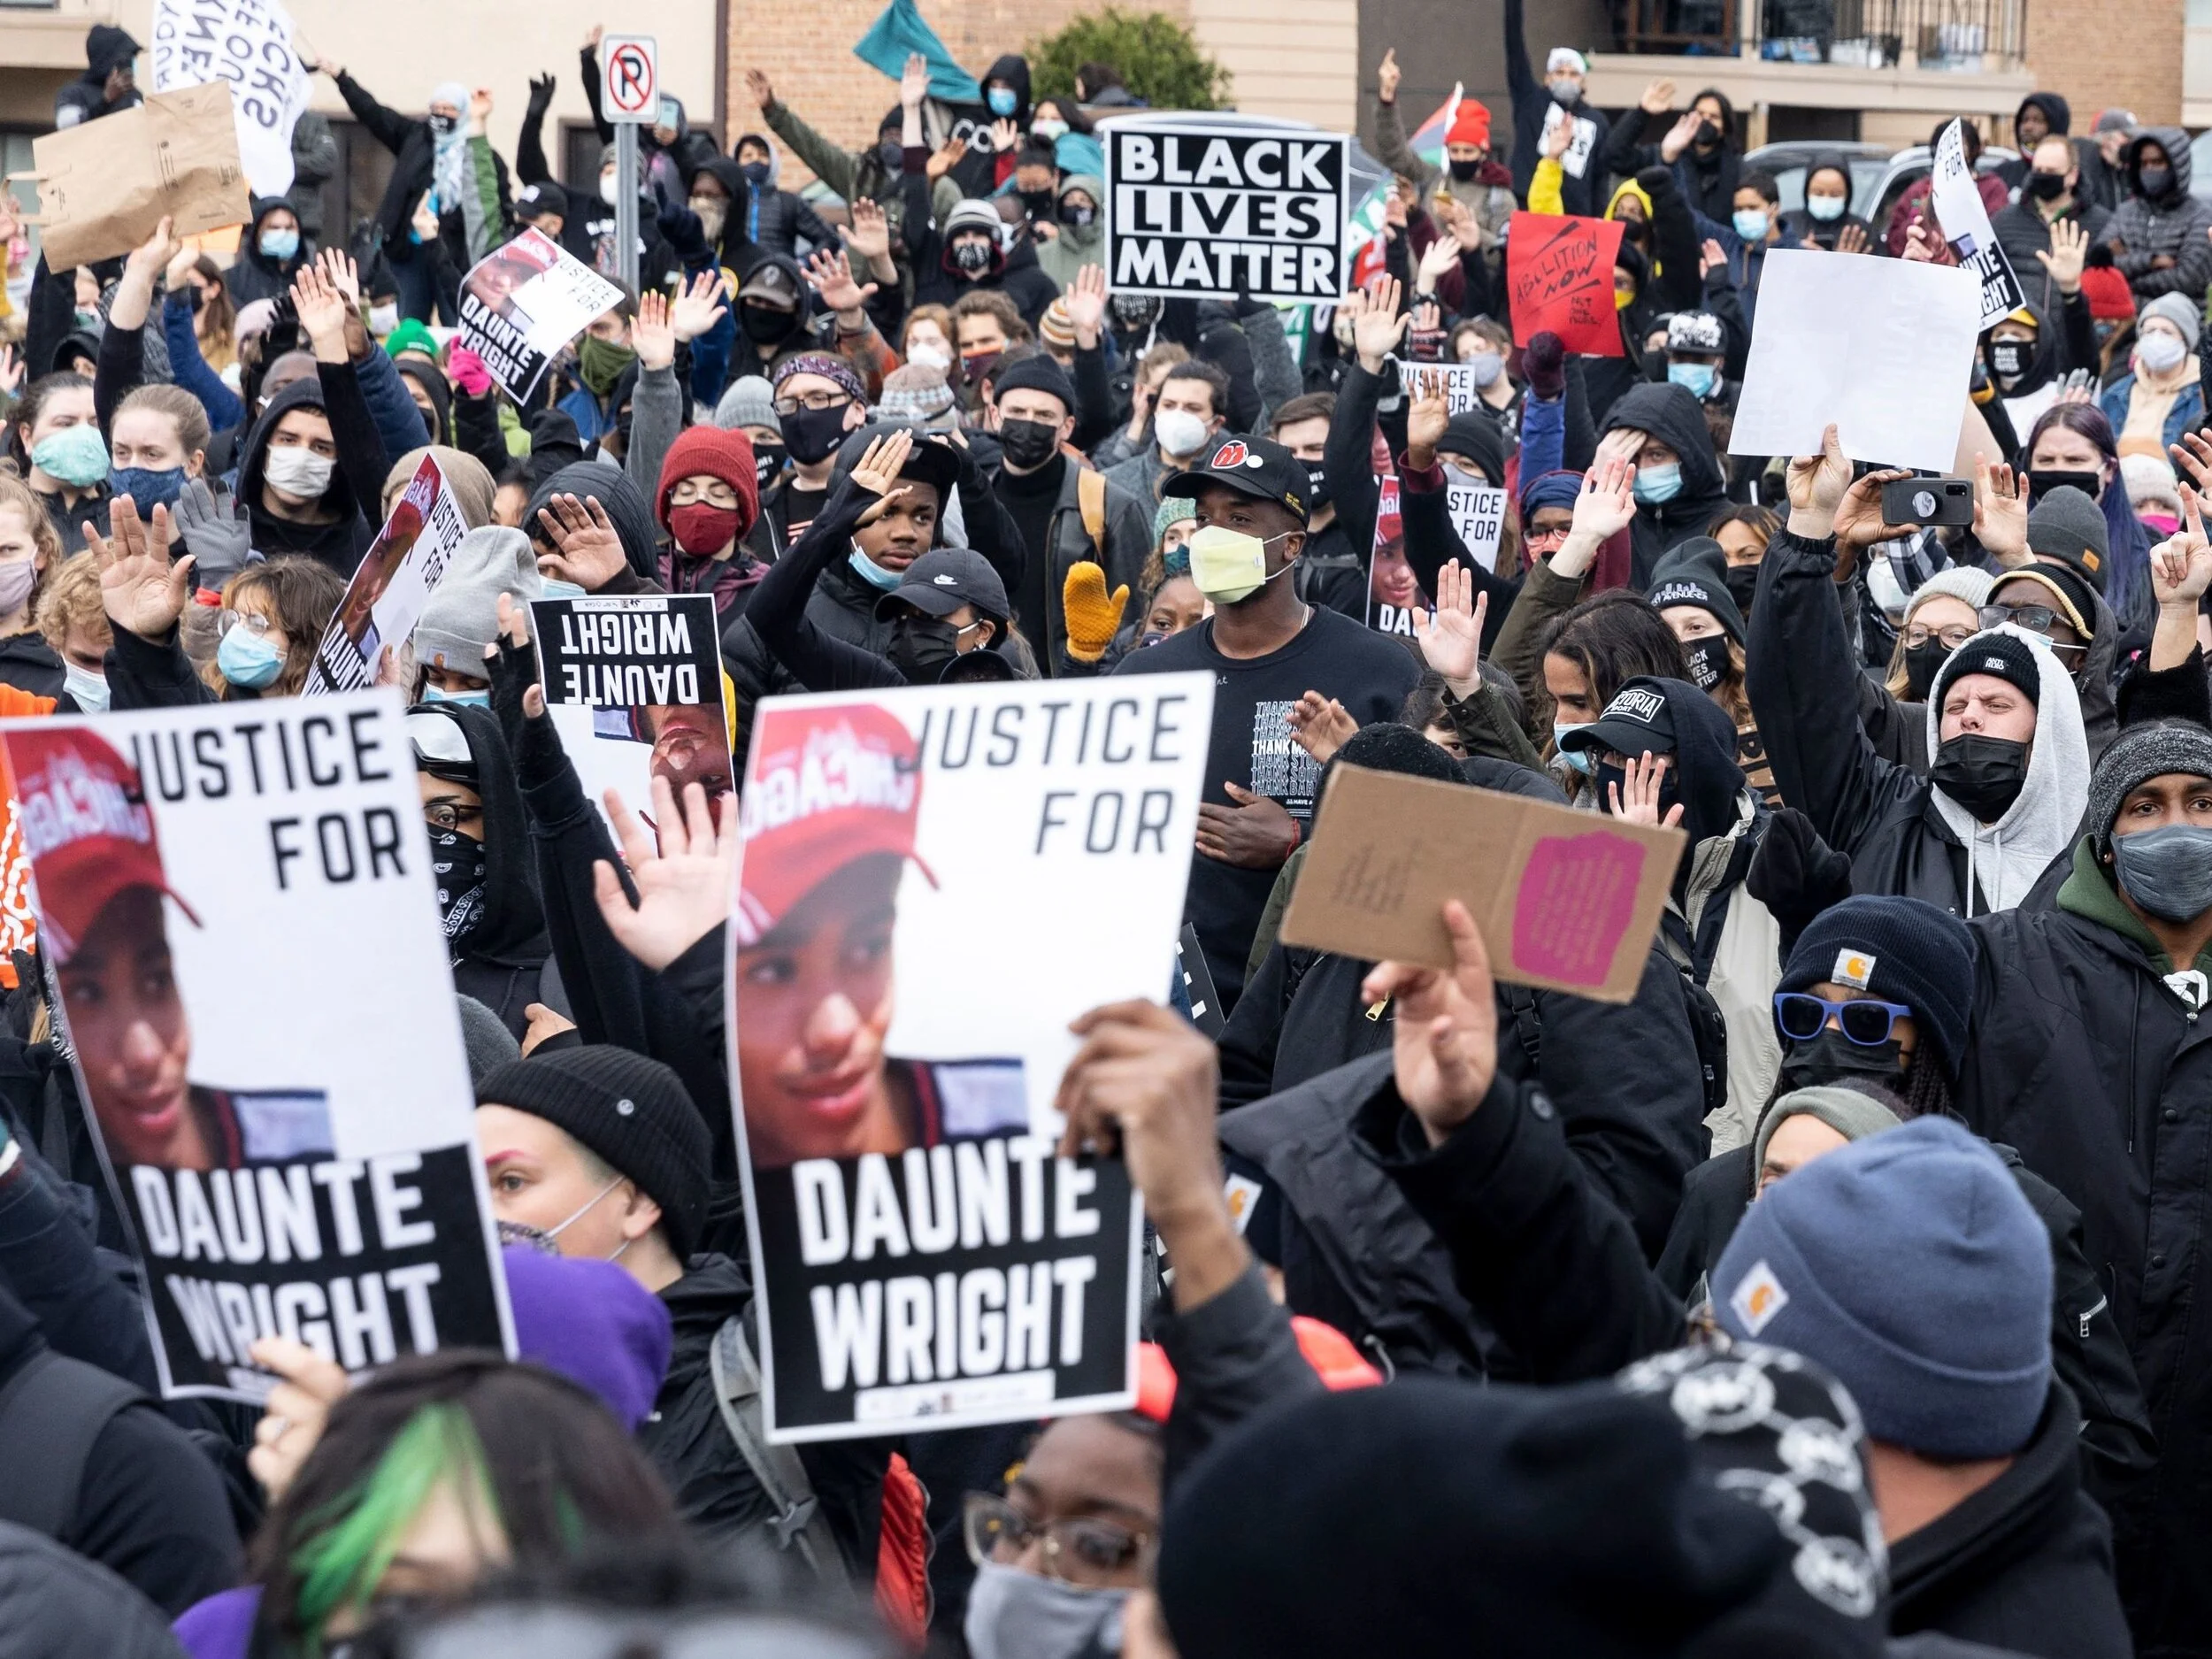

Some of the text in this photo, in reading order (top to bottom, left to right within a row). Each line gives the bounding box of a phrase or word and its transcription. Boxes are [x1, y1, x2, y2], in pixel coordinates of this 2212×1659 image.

[1120, 134, 1333, 190] BLACK
[1945, 150, 1964, 181] FOR
[1133, 189, 1321, 240] LIVES
[1116, 237, 1338, 295] MATTER
[1543, 254, 1598, 299] NOW
[567, 286, 603, 312] FOR
[460, 293, 539, 369] DAUNTE
[429, 488, 465, 560] JUSTICE
[1449, 491, 1502, 515] STICE
[1463, 518, 1498, 541] FOR
[560, 613, 693, 656] WRIGHT
[562, 664, 699, 706] DAUNTE
[122, 710, 391, 803] JUSTICE
[893, 695, 1187, 774] JUSTICE
[1252, 740, 1291, 755] THANK
[1252, 754, 1289, 768] THANK
[1251, 767, 1289, 782] THANK
[1251, 780, 1289, 795] THANK
[269, 805, 406, 890] FOR
[1033, 788, 1176, 856] FOR
[129, 1151, 437, 1265] DAUNTE
[791, 1136, 1102, 1267] DAUNTE
[163, 1262, 442, 1371] WRIGHT
[809, 1253, 1098, 1393] WRIGHT
